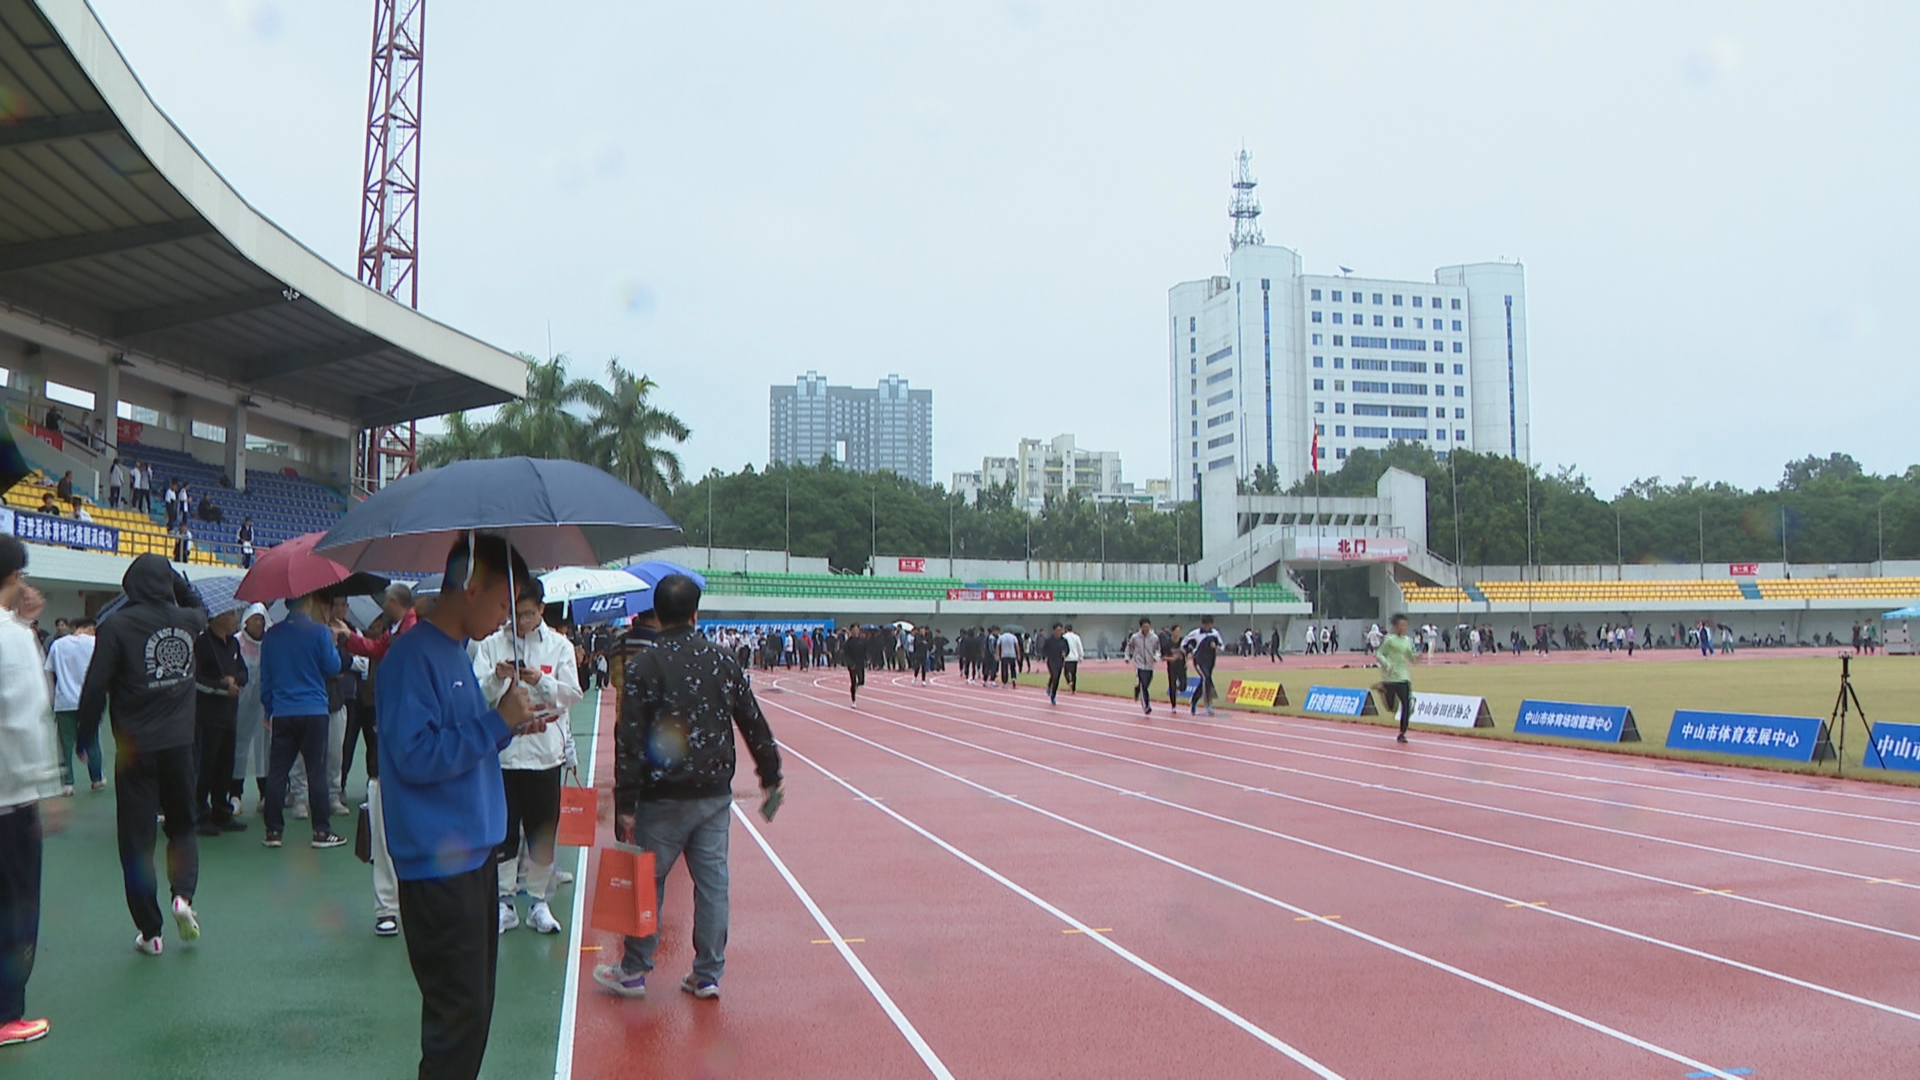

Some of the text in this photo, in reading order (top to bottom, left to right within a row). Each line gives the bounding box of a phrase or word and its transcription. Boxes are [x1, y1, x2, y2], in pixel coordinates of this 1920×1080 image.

[1338, 539, 1366, 553] 北门
[1306, 692, 1360, 715] 好宽带用移动
[1417, 701, 1472, 720] 中山市田径协会
[1524, 710, 1613, 731] 中山市体育场馆管理中心
[1681, 722, 1800, 748] 中山市体育发展中心
